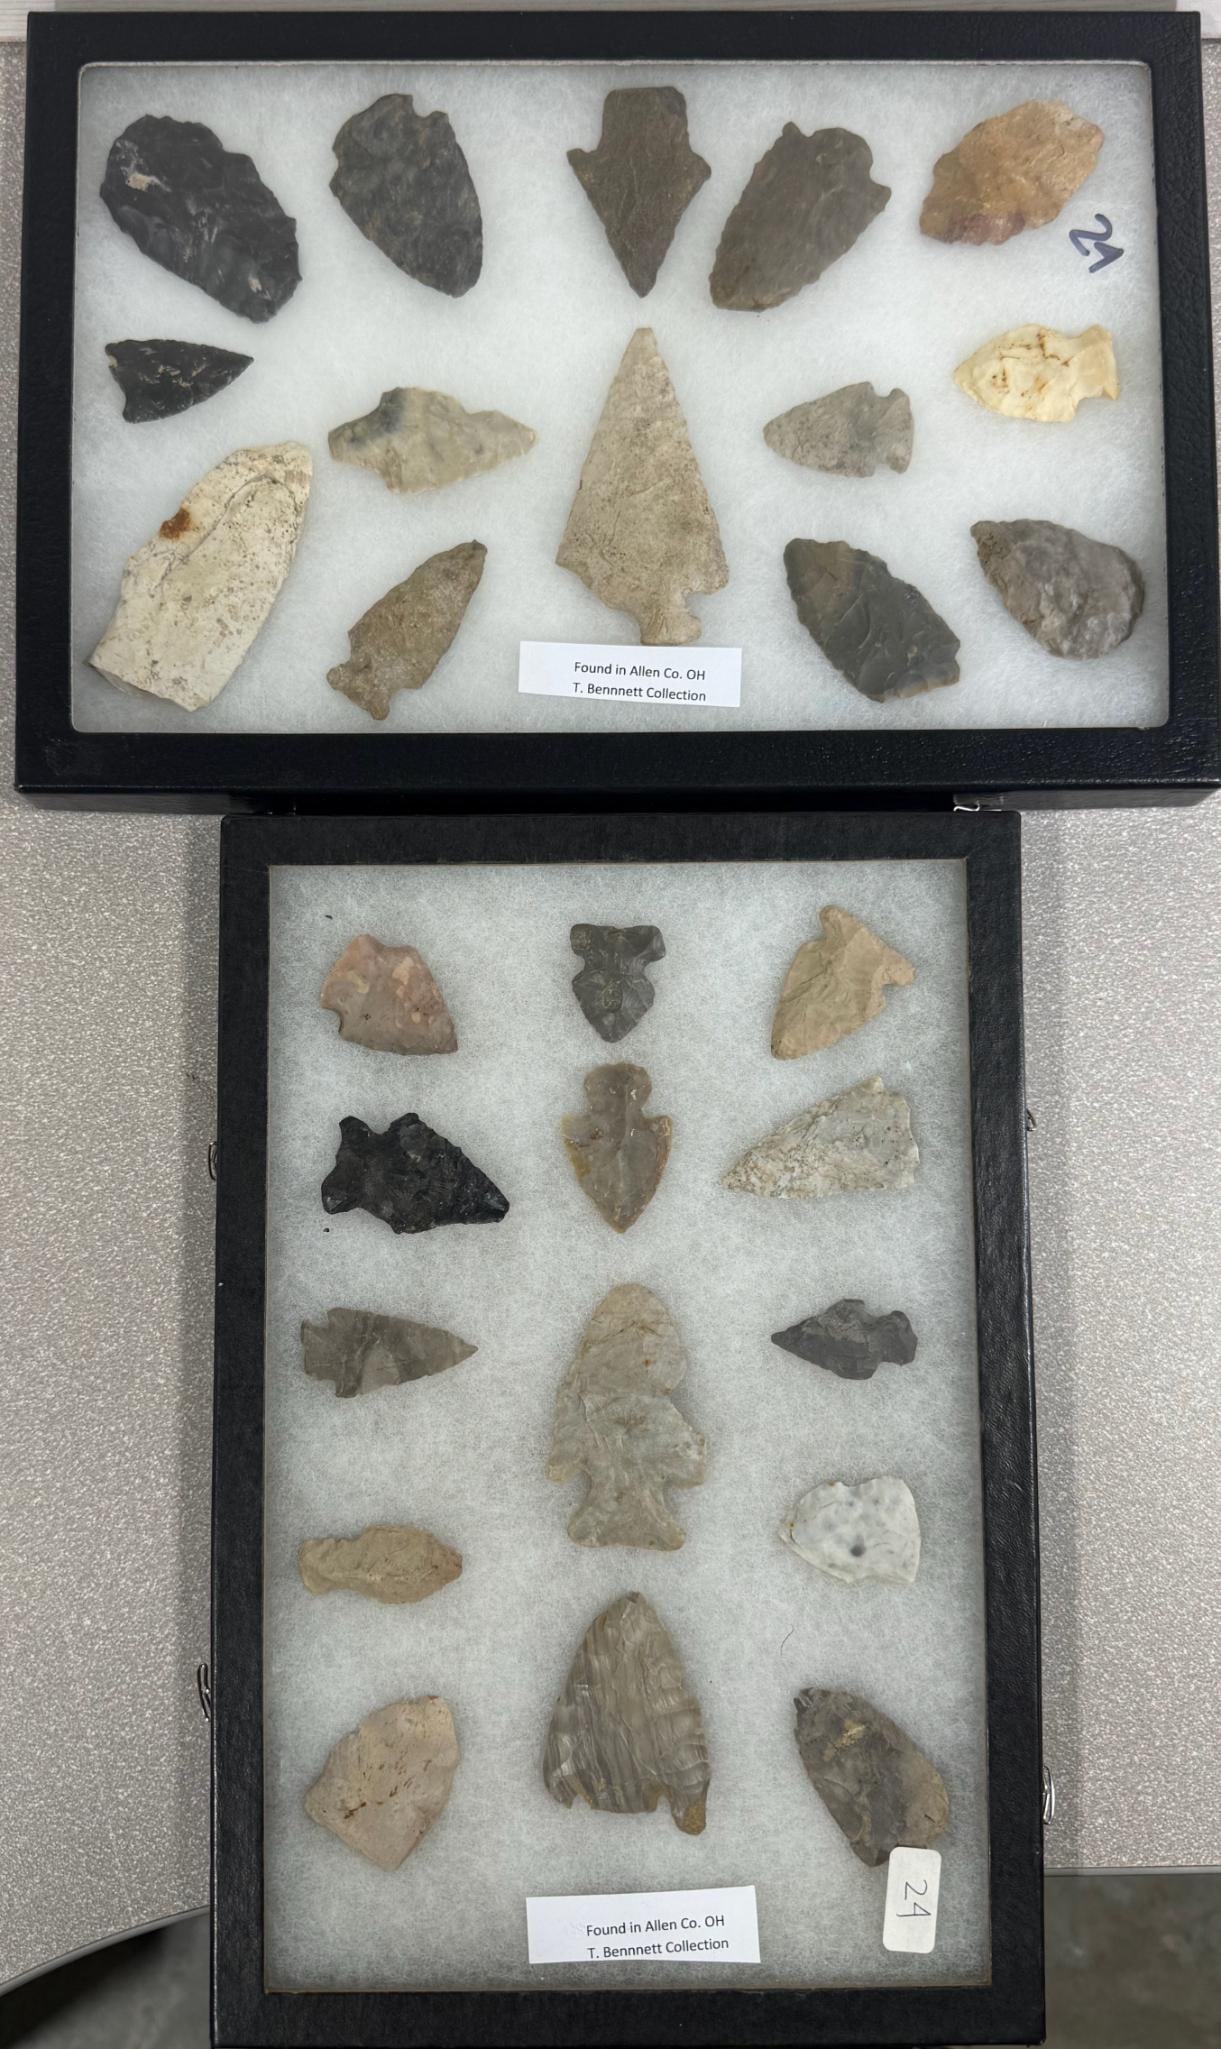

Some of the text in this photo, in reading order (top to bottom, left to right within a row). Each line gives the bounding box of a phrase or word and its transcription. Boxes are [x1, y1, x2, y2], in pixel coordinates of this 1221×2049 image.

[574, 662, 705, 680] Found in Allen Co. OH
[573, 682, 706, 702] T. Bennnett Collection
[896, 1879, 932, 1917] 24
[587, 1915, 724, 1936] Found in Allen Co. OH
[588, 1939, 728, 1959] T. Bennnett Collection
